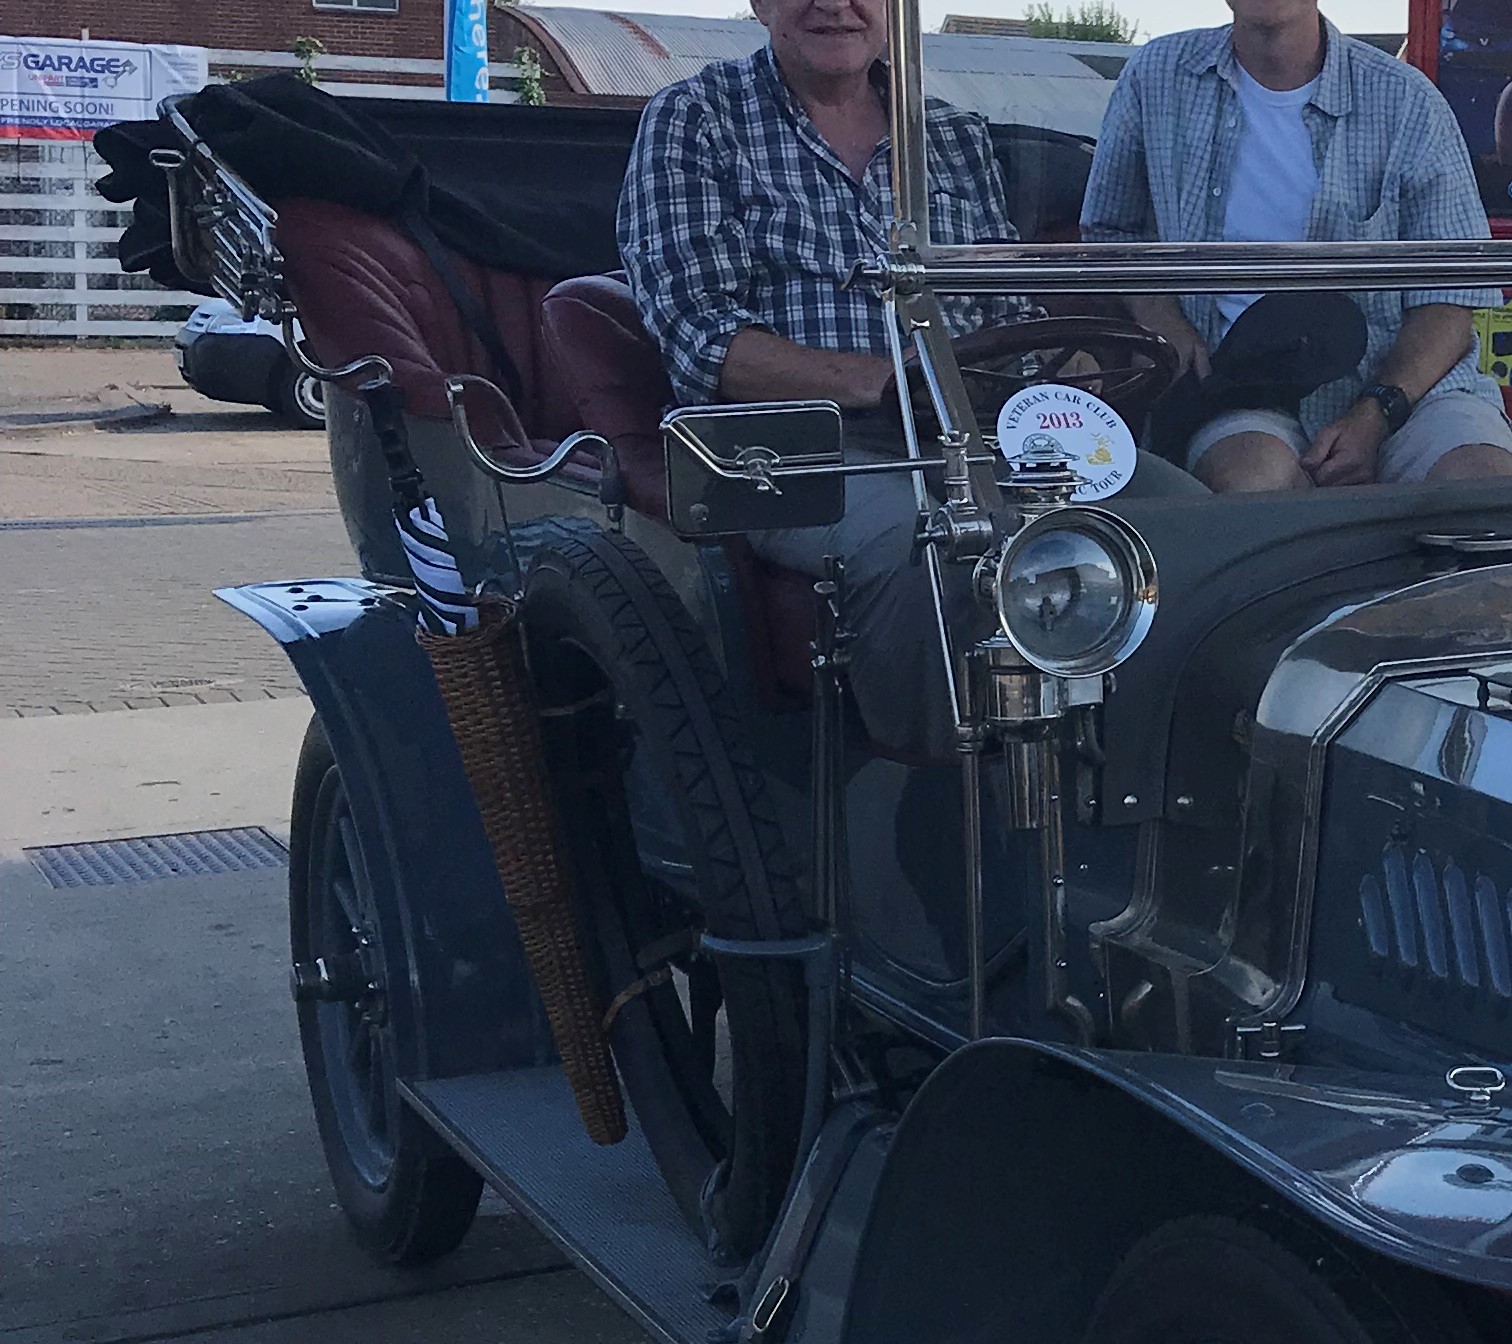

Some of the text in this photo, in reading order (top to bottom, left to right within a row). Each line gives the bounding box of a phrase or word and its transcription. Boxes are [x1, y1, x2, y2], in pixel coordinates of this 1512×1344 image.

[22, 53, 121, 75] GARAGE
[63, 101, 115, 117] SOON!
[1006, 390, 1118, 430] VETERAN CAR CLUB
[1036, 411, 1084, 430] 2013
[1090, 469, 1123, 494] TOUR
